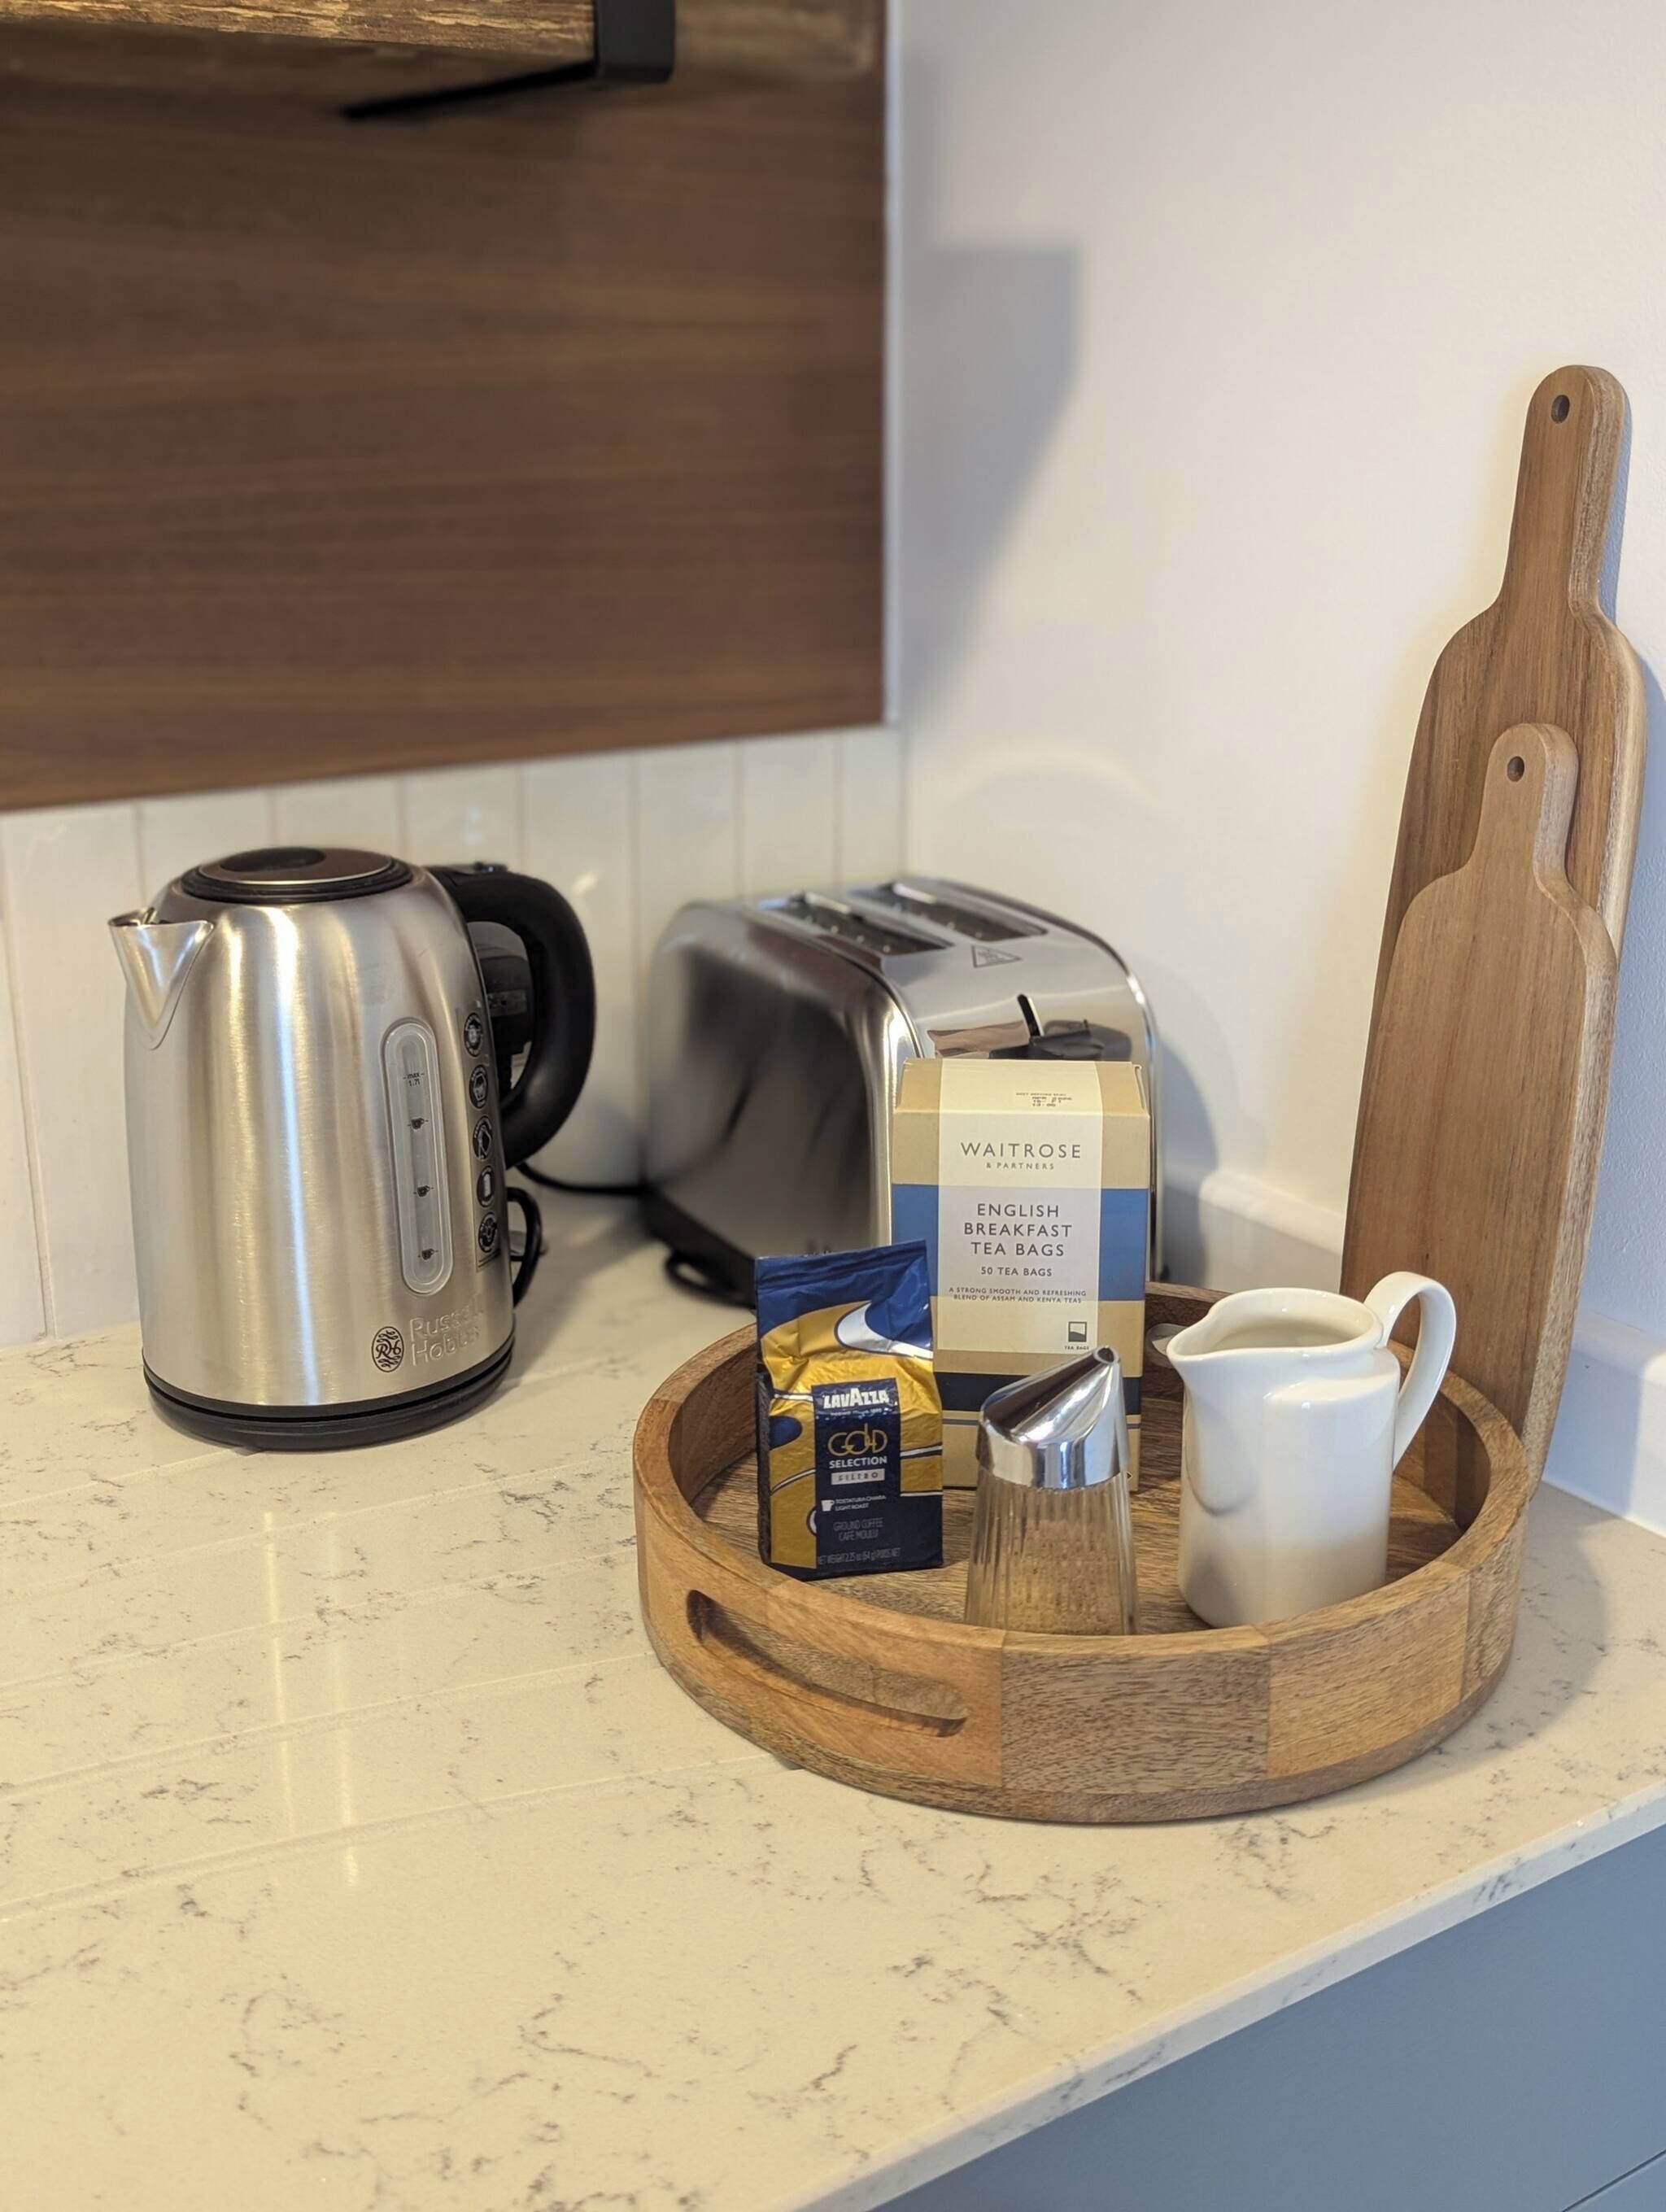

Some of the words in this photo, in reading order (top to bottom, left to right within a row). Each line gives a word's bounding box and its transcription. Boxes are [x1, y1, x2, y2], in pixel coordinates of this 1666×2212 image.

[961, 1142, 1081, 1158] WAITROSE
[997, 1162, 1055, 1170] PARTNERS
[977, 1203, 1059, 1218] ENGLISH
[964, 1222, 1072, 1237] BREAKFAST
[970, 1241, 1006, 1255] TEA
[1016, 1243, 1065, 1257] BAGS
[981, 1266, 993, 1275] 50
[997, 1267, 1018, 1276] TEA
[1023, 1267, 1053, 1276] BAGS
[823, 1388, 890, 1409] LAVAZZA
[827, 1423, 888, 1456] GOLD
[829, 1456, 888, 1468] SELECTION
